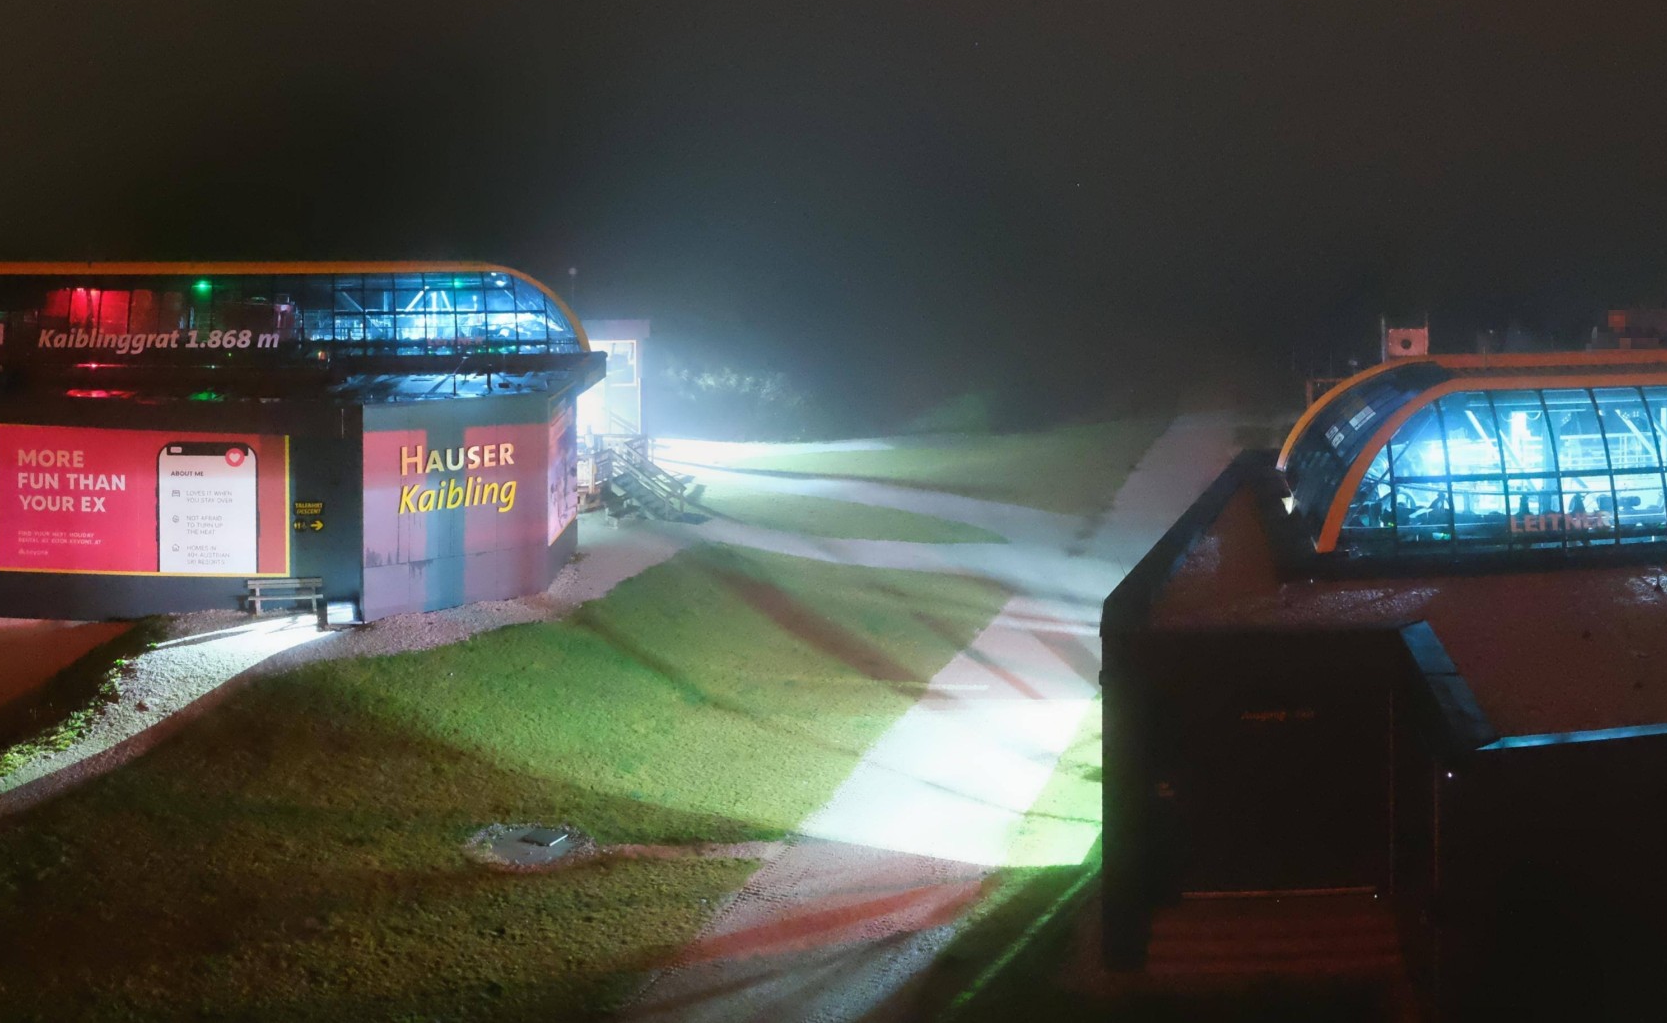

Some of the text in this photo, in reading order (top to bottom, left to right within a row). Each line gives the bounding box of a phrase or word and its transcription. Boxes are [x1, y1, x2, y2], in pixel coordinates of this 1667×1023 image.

[38, 329, 279, 354] Kaiblinggrat 1.868 m
[18, 449, 84, 468] MORE
[400, 443, 515, 476] HAUSER
[18, 472, 126, 491] FUN THAN
[19, 495, 106, 512] YOUR EX
[399, 477, 517, 515] Kaibling
[1510, 511, 1613, 533] LEITNER
